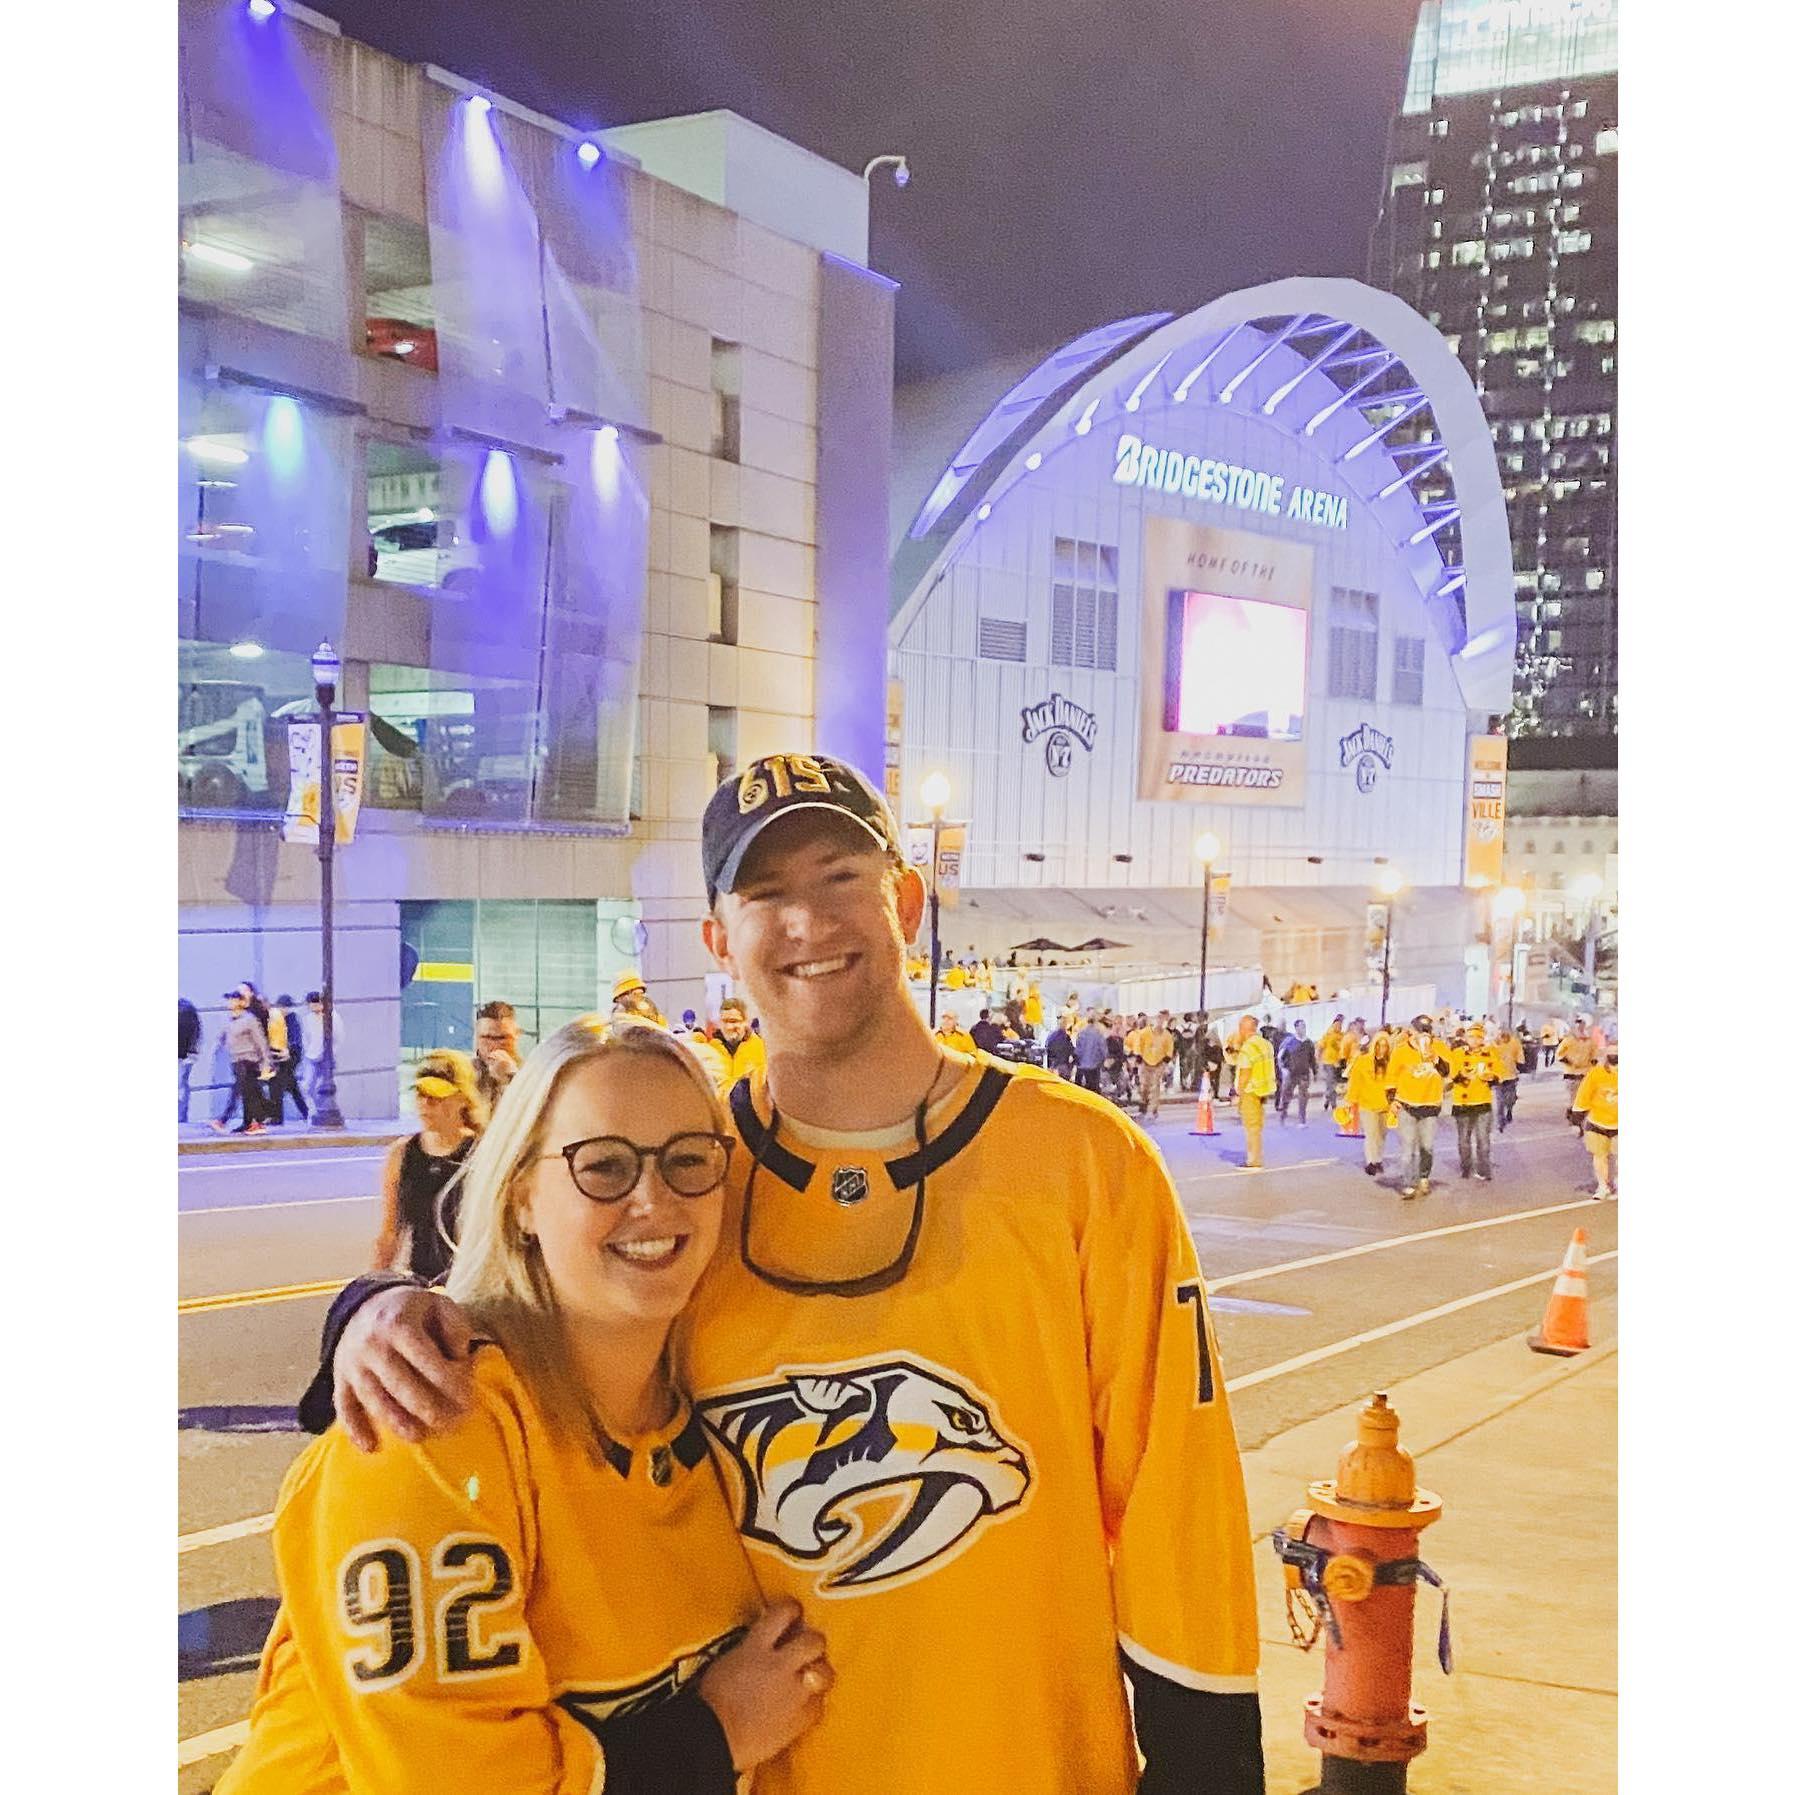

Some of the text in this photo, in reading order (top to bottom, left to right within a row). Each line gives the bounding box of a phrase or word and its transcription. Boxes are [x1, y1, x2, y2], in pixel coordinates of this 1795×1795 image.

[1114, 435, 1348, 531] BRIDGESTONE ARENA
[738, 753, 831, 814] 615
[1168, 763, 1283, 788] PREDATORS
[1472, 801, 1501, 820] VILLE
[939, 864, 960, 877] US
[338, 1532, 528, 1693] 92
